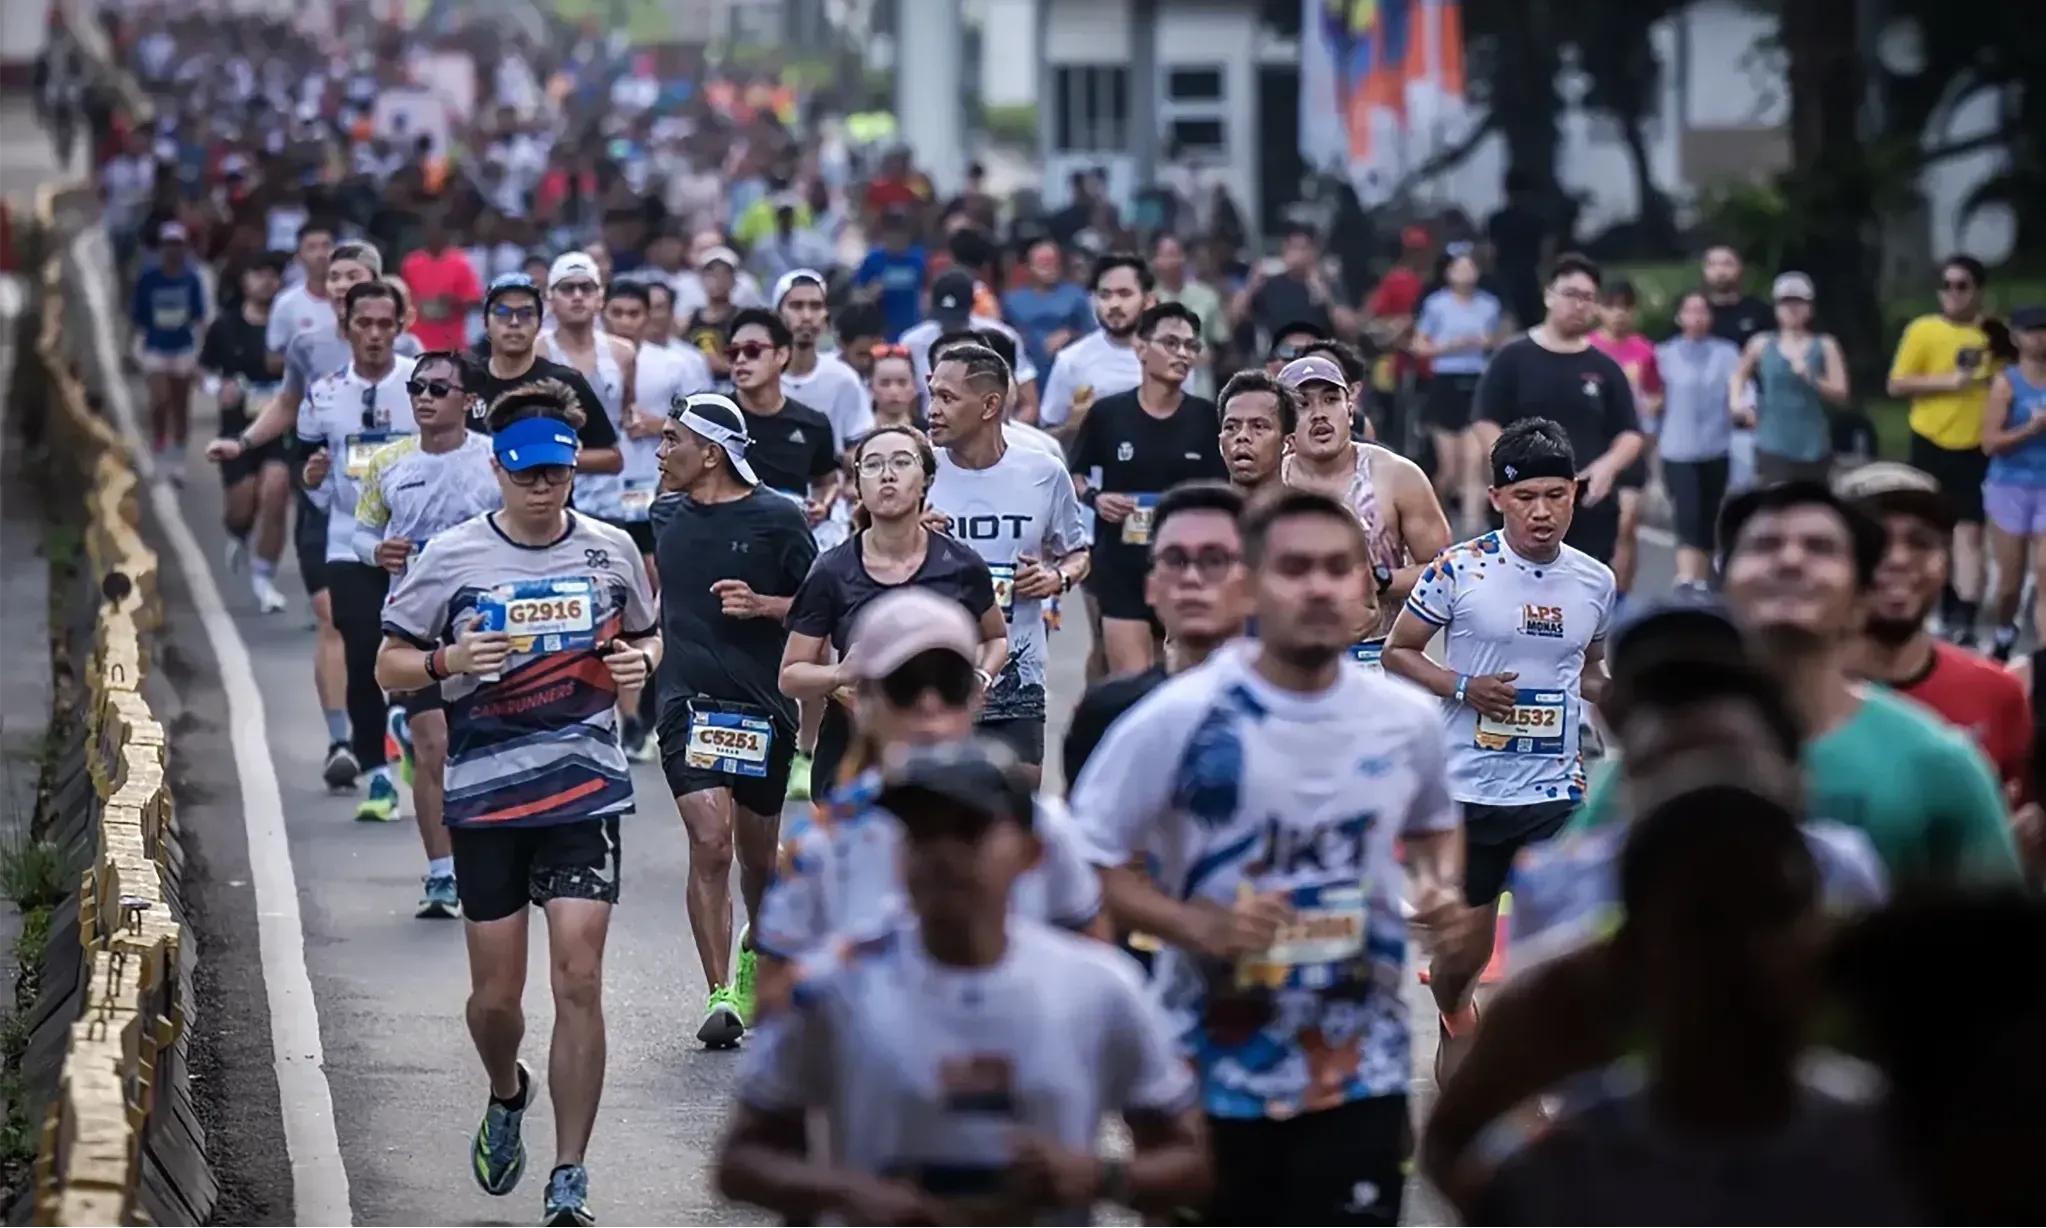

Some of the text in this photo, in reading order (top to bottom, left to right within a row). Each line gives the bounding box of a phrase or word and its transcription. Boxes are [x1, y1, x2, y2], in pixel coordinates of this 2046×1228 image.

[509, 600, 581, 623] G2916
[1526, 604, 1562, 622] LPS
[1500, 708, 1556, 727] 1532
[700, 729, 759, 752] C5251
